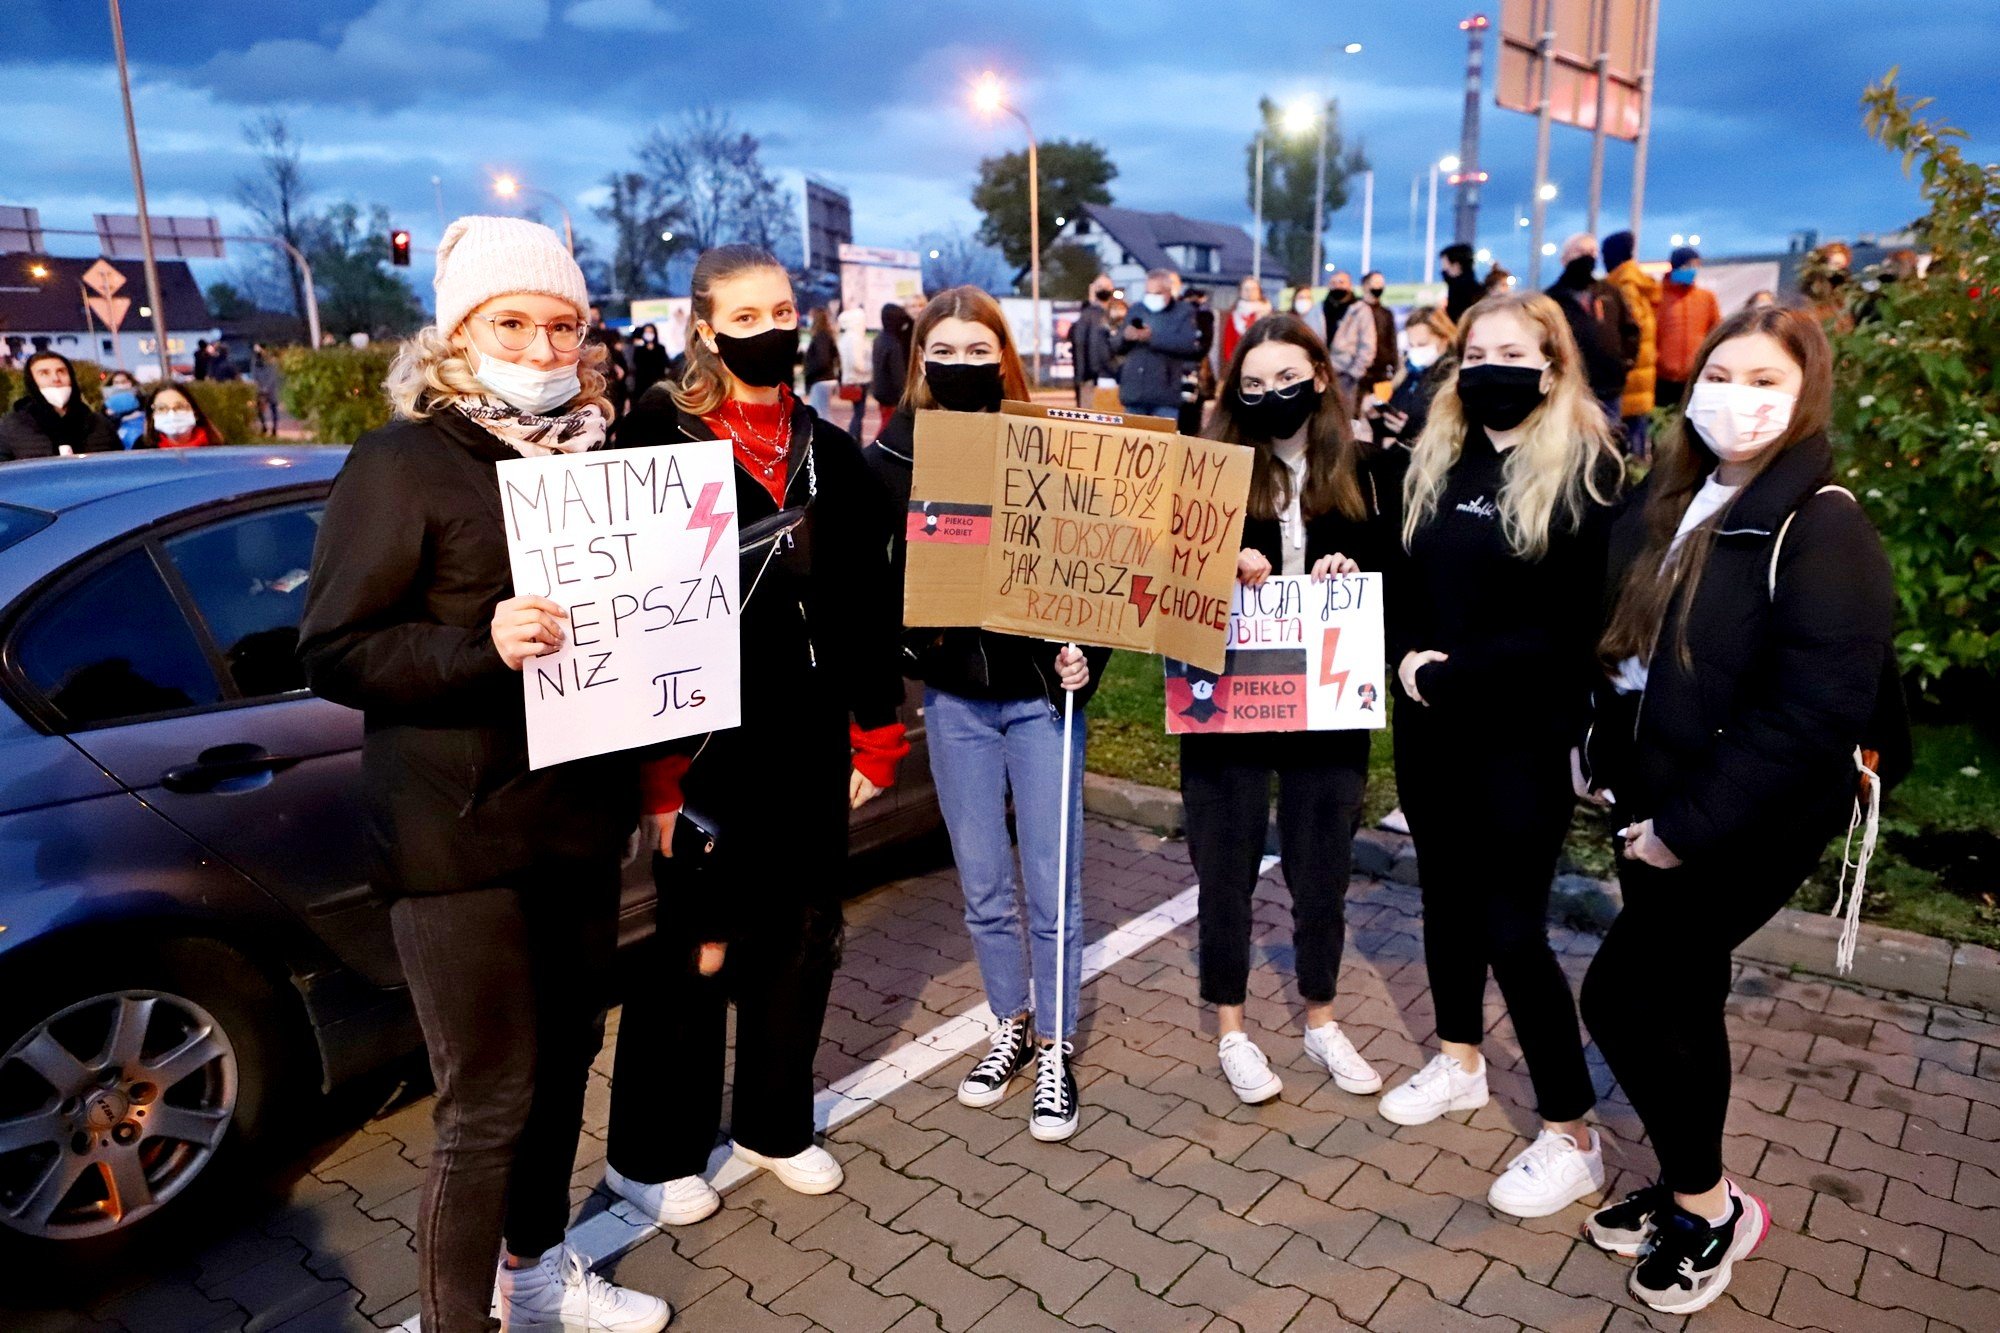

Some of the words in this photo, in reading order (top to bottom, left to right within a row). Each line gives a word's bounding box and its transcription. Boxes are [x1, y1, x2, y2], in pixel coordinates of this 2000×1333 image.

[1005, 422, 1113, 472] NAWET
[1114, 435, 1169, 496] MÓJ
[1180, 446, 1228, 497] MY
[506, 454, 692, 541] MATMA
[1004, 468, 1051, 512] EX
[1062, 473, 1106, 517] NIE
[943, 528, 973, 537] KOBIET
[944, 517, 974, 526] PIEKŁO
[1000, 511, 1042, 549] TAK
[1051, 516, 1163, 568] TOKSYCZNY
[1170, 493, 1238, 553] BODY
[524, 533, 637, 599] JEST
[999, 550, 1042, 596] JAK
[1050, 558, 1128, 597] NASZ
[1172, 545, 1210, 581] MY
[535, 574, 731, 658] EPSZA
[1159, 585, 1228, 631] CHOICE
[1231, 580, 1301, 619] UCJA
[1320, 577, 1369, 622] JEST
[1233, 681, 1296, 696] PIEKŁO
[1233, 704, 1297, 719] KOBIET
